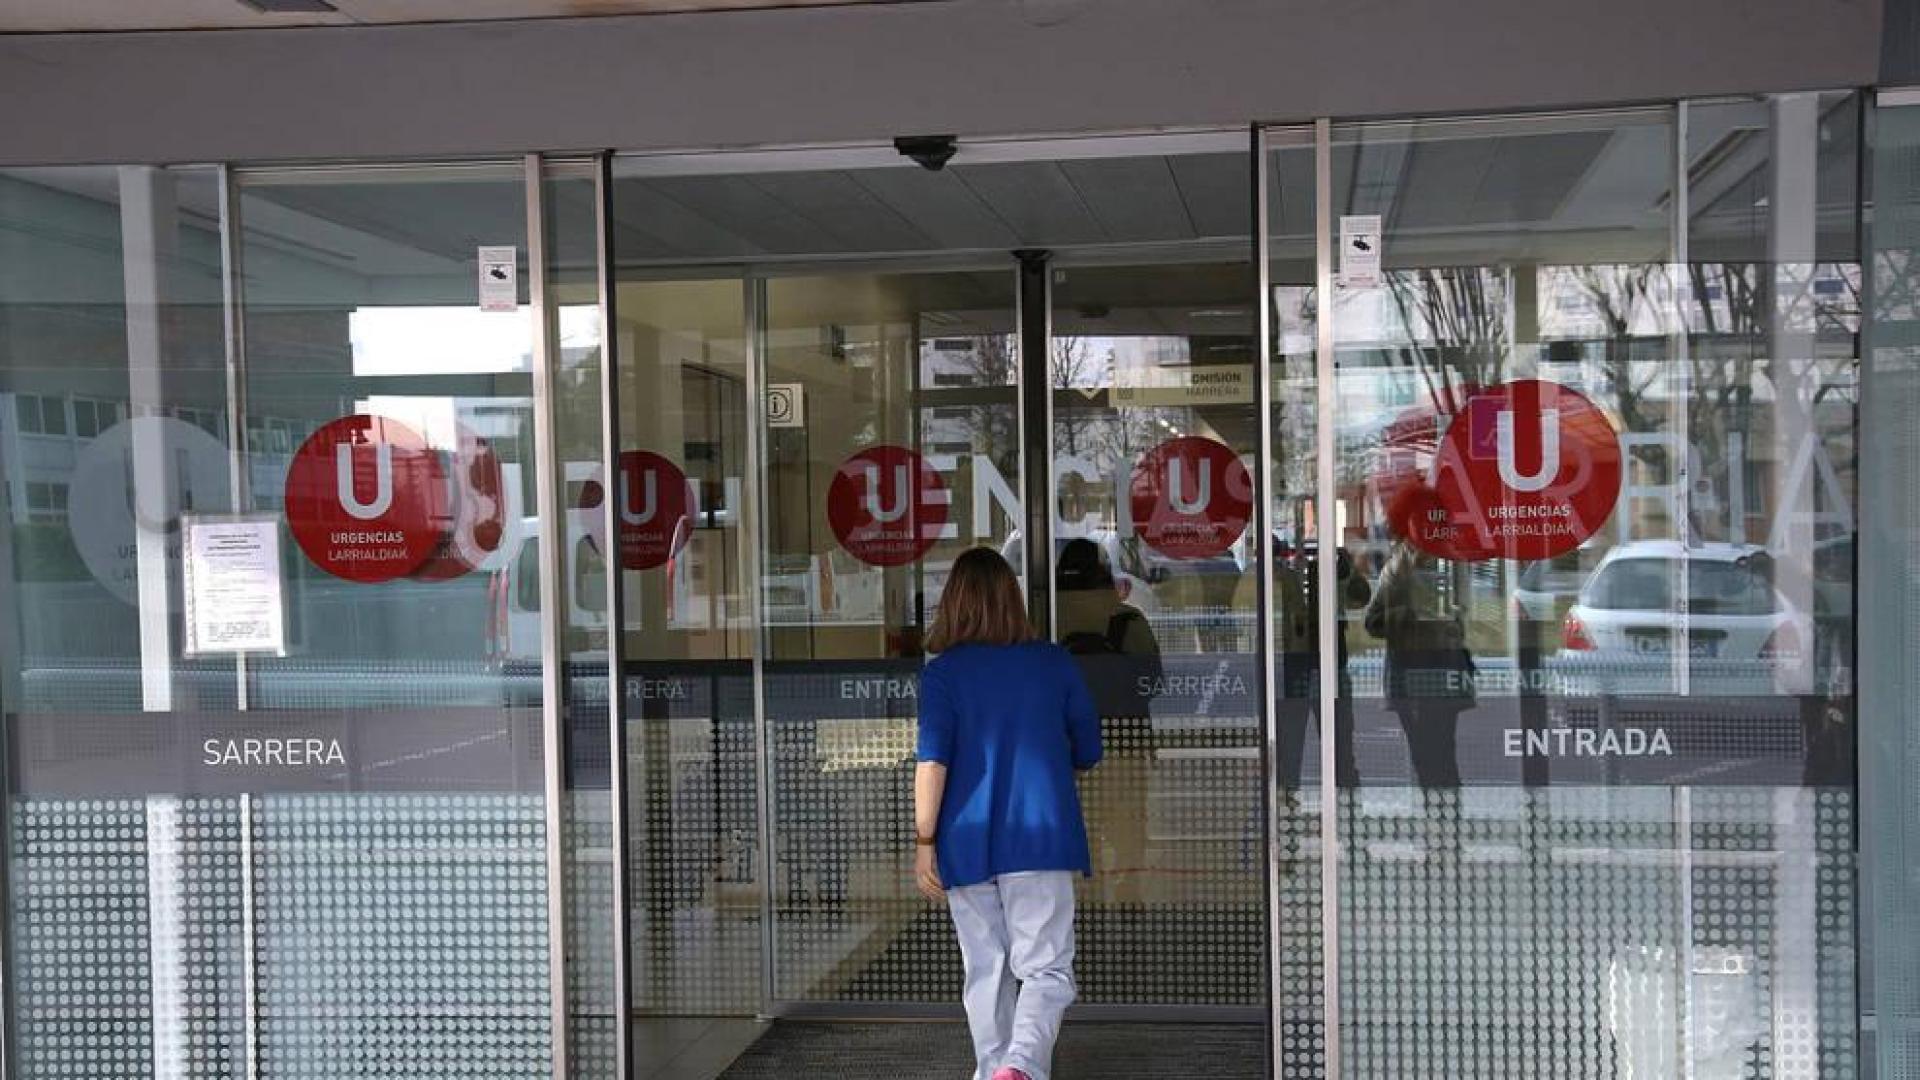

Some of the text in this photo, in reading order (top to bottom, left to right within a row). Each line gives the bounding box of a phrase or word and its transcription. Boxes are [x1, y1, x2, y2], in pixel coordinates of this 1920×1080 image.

[1497, 408, 1560, 492] U
[336, 442, 393, 520] U
[1168, 456, 1211, 515] U
[1488, 504, 1572, 519] URGENCIAS
[331, 532, 404, 544] URGENCIAS
[1485, 523, 1576, 537] LARRIALDIAK
[328, 548, 408, 561] LARRIALDIAK
[1136, 675, 1248, 697] SARRERA
[203, 738, 346, 765] SARRERA
[1503, 728, 1673, 757] ENTRADA
